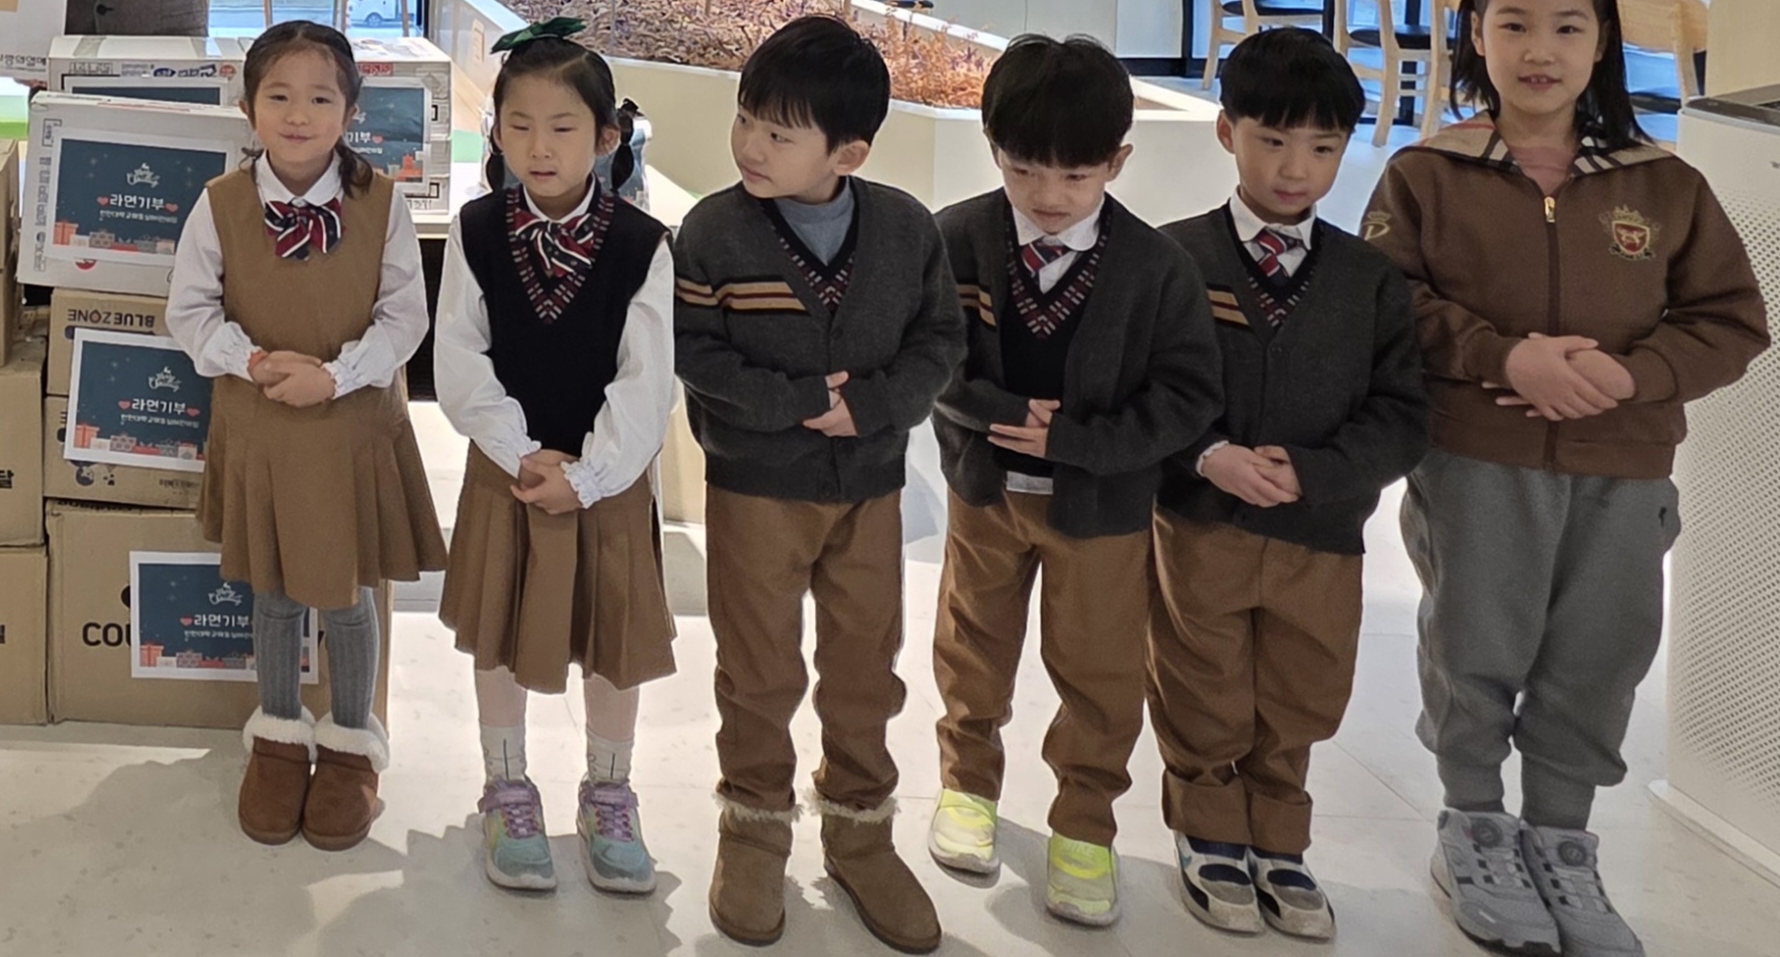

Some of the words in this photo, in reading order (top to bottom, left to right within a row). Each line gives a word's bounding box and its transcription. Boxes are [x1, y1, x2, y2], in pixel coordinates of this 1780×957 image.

[347, 131, 371, 143] 기부
[109, 194, 164, 211] 라면기부
[131, 398, 186, 414] 라면기부
[194, 614, 249, 628] 라면기부
